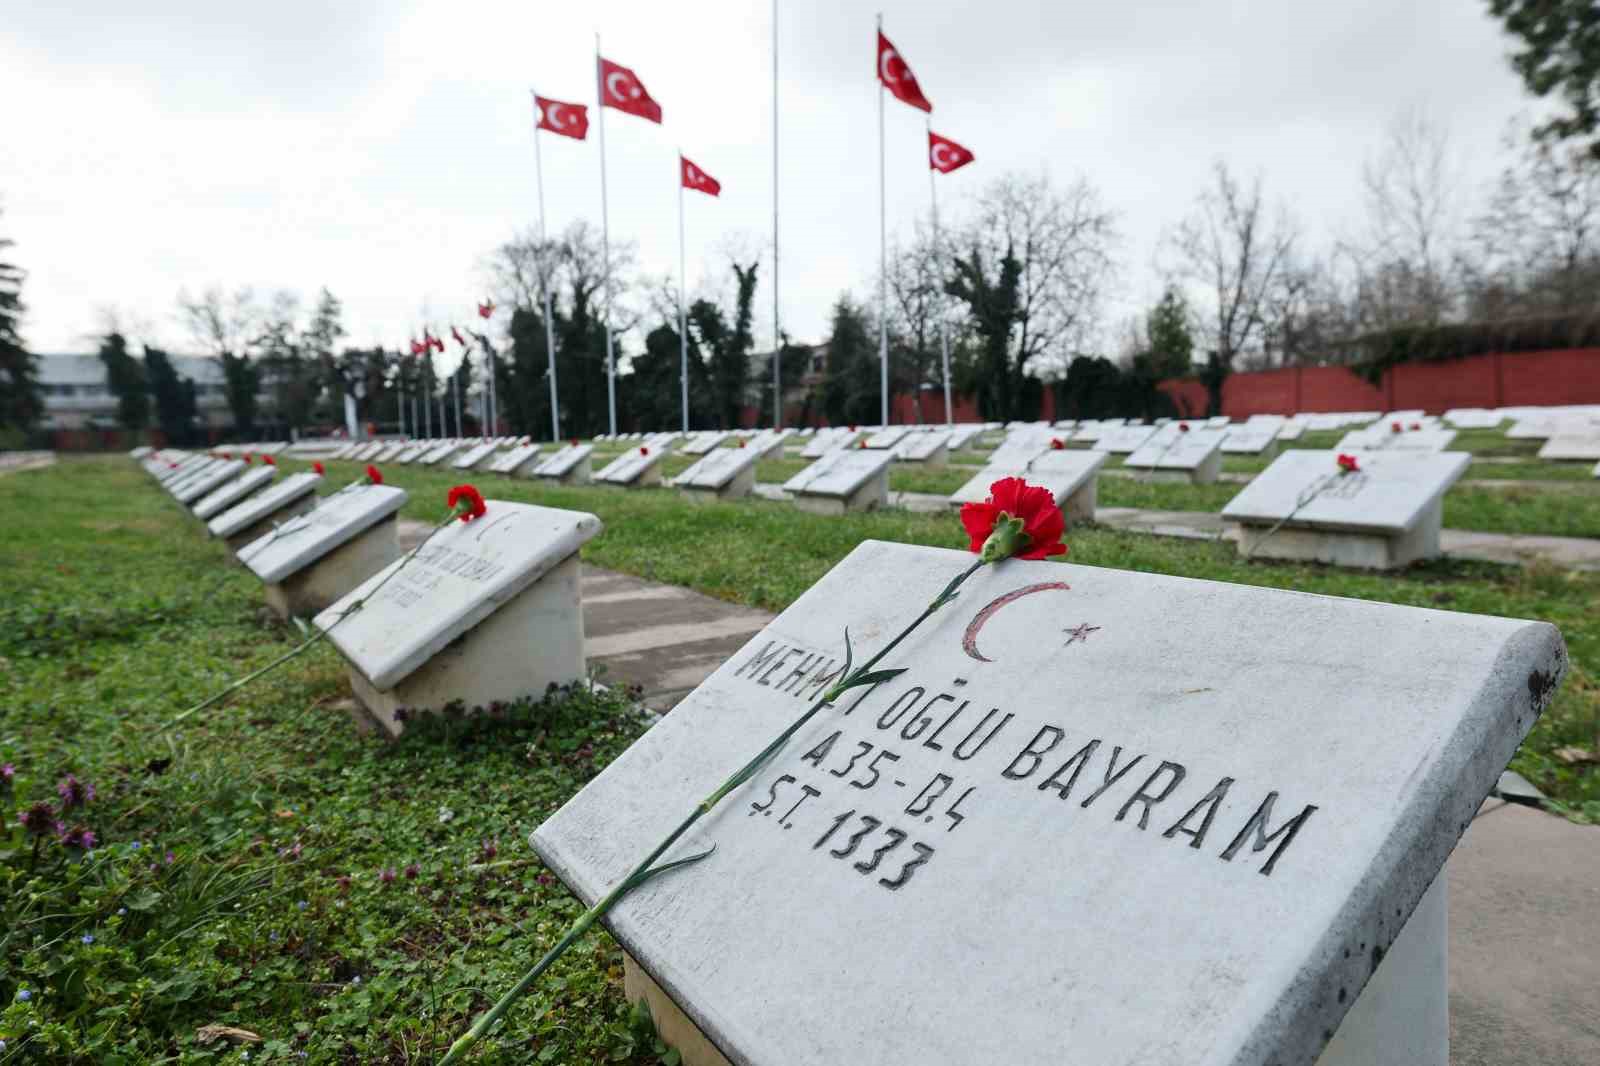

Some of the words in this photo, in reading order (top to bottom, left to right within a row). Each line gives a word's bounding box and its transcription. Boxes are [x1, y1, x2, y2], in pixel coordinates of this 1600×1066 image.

[734, 639, 891, 716] MEHMT
[876, 677, 1016, 761] OĞLU
[1001, 724, 1319, 877] BAYRAM
[812, 809, 936, 891] 1333
